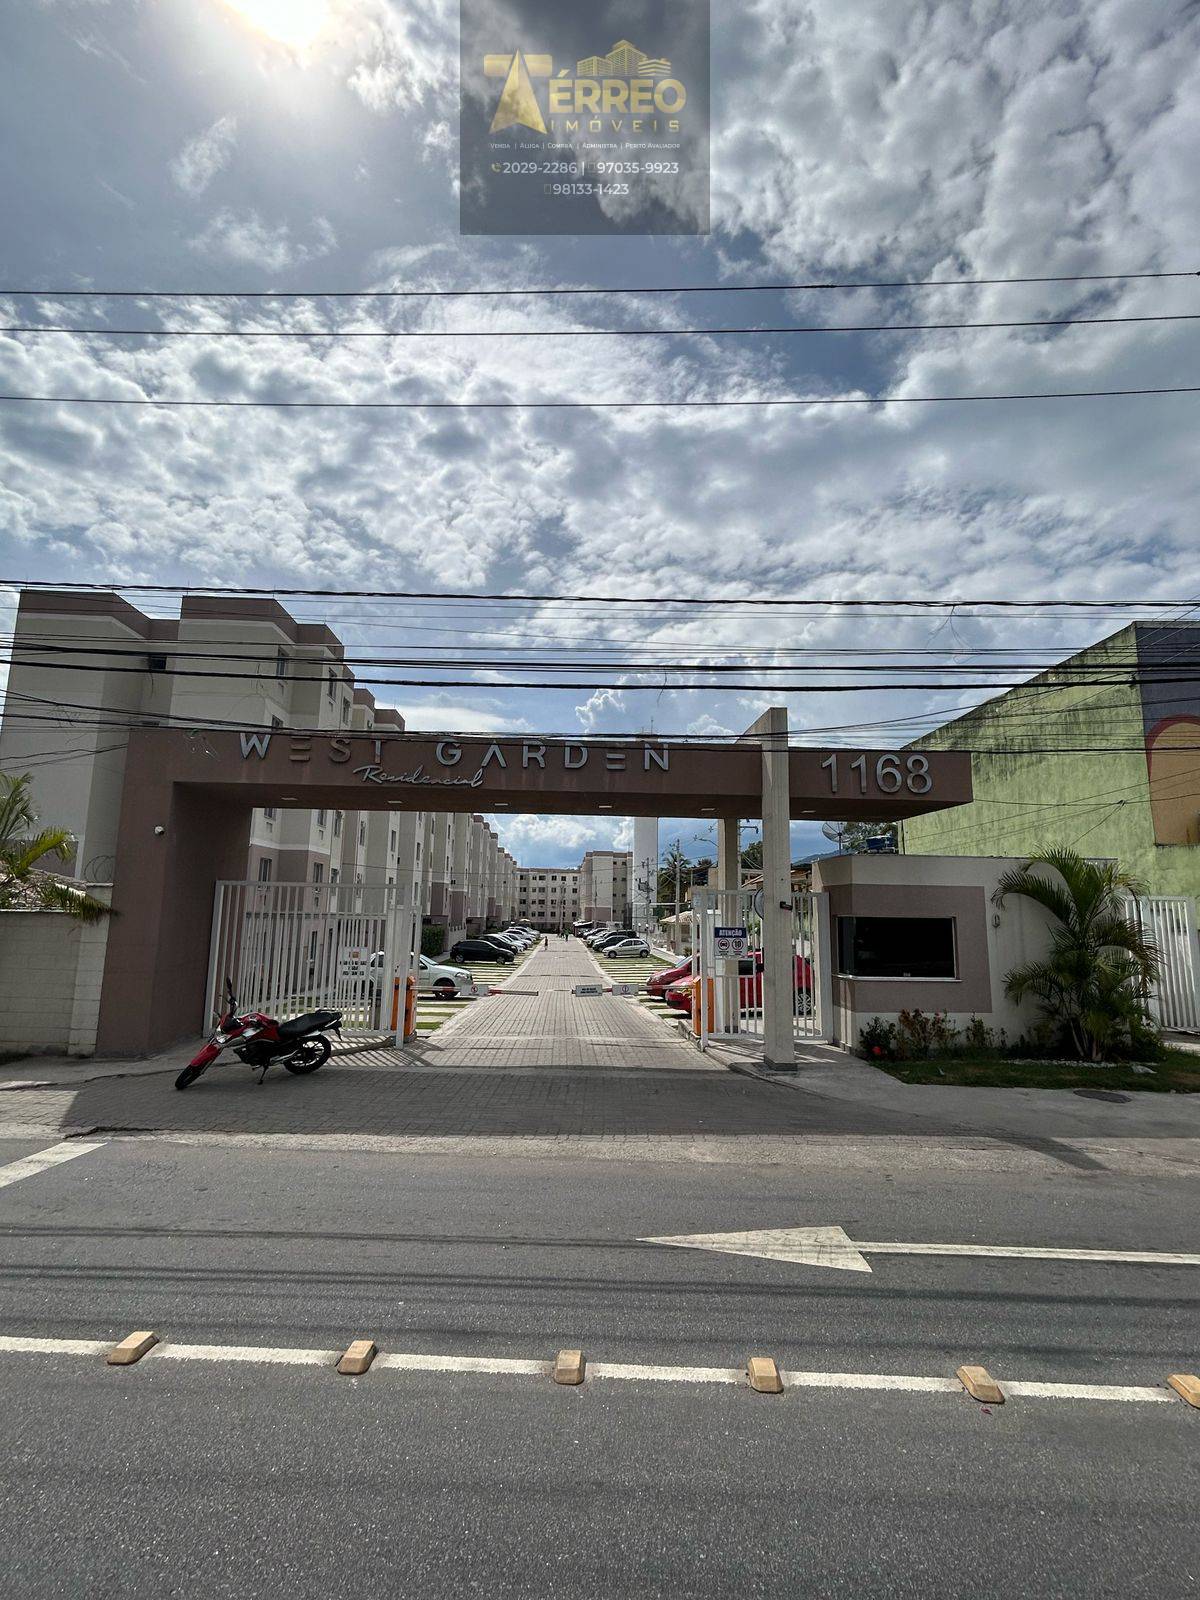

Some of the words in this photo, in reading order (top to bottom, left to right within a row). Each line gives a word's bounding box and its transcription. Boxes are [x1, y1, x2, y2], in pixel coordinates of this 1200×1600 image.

[239, 731, 388, 764] WEST
[435, 738, 669, 771] GARDEN
[353, 765, 484, 788] Residencial
[821, 753, 933, 795] 1168
[719, 929, 743, 937] ATENÇÃO
